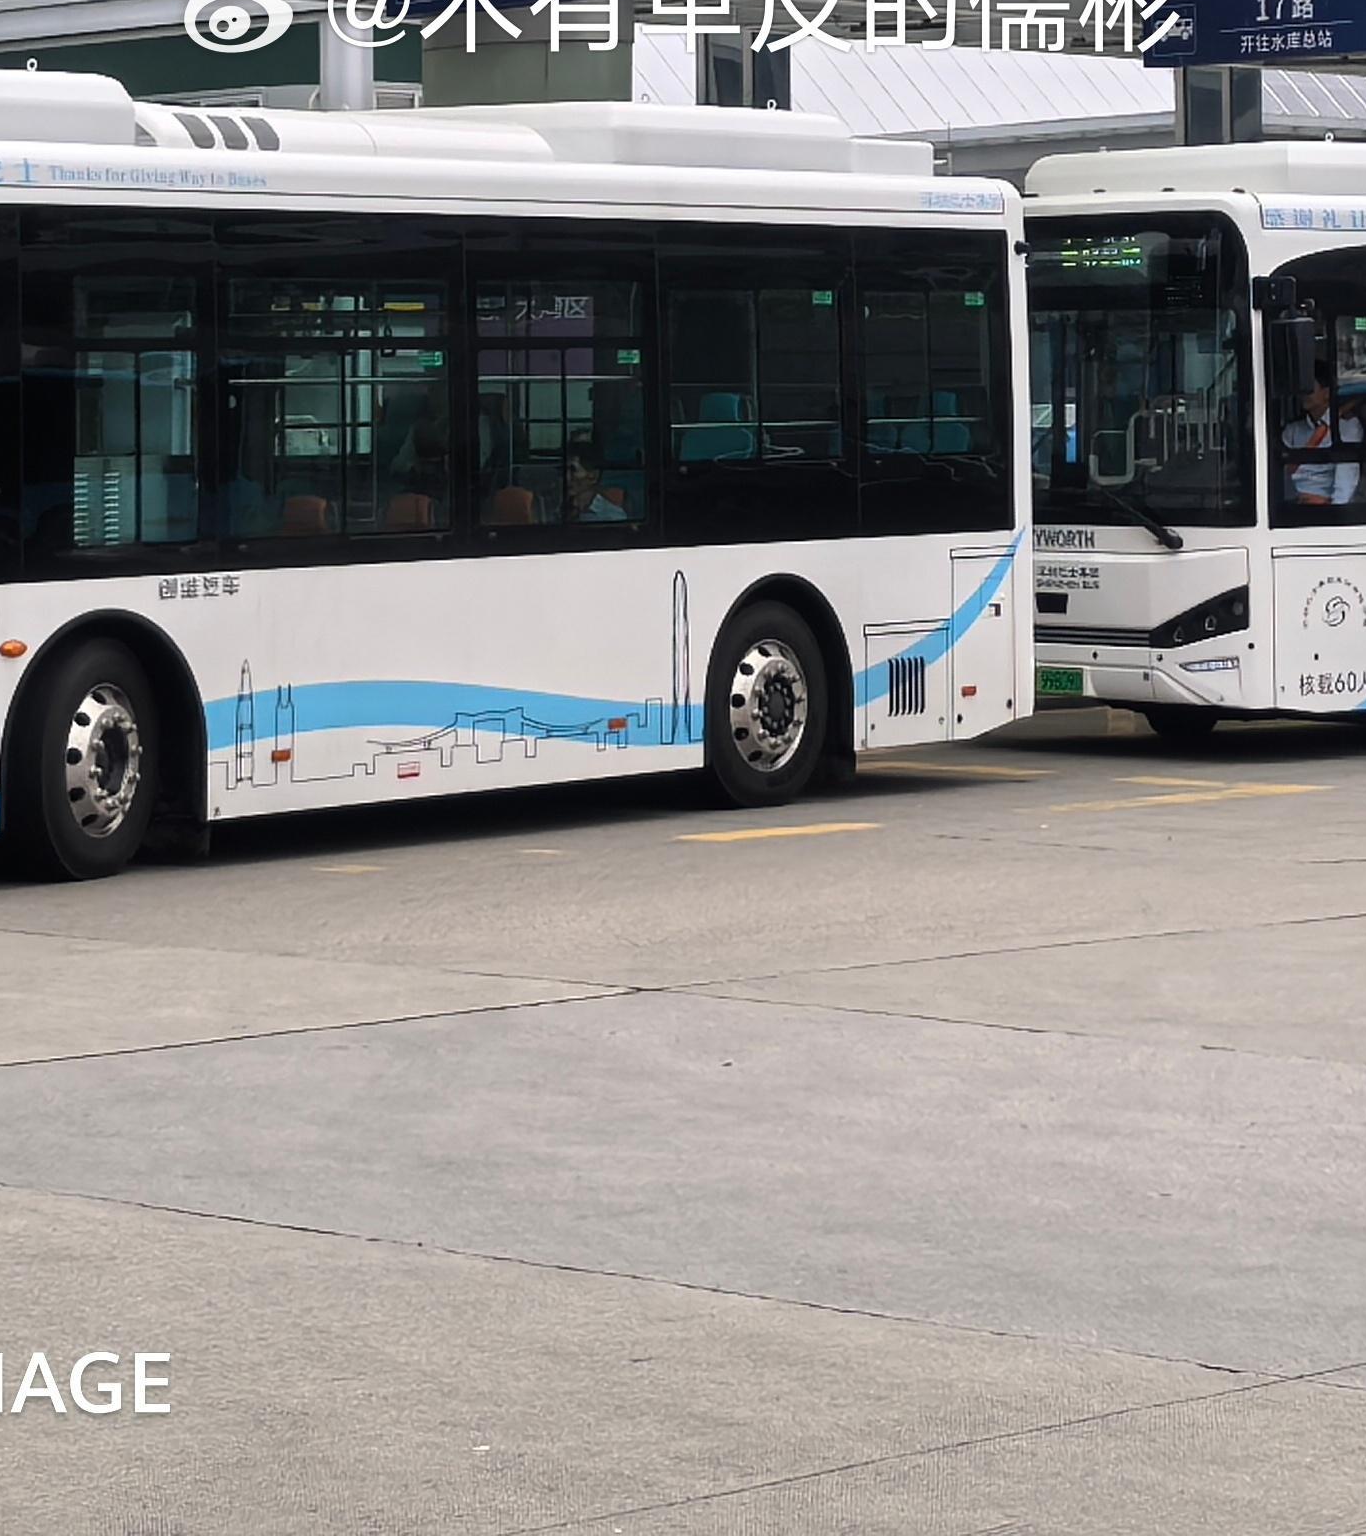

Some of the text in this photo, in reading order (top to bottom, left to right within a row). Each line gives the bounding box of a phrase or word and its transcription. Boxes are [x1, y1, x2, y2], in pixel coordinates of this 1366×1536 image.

[1239, 28, 1334, 54] 开往水库总站
[1034, 528, 1095, 549] YWORTH
